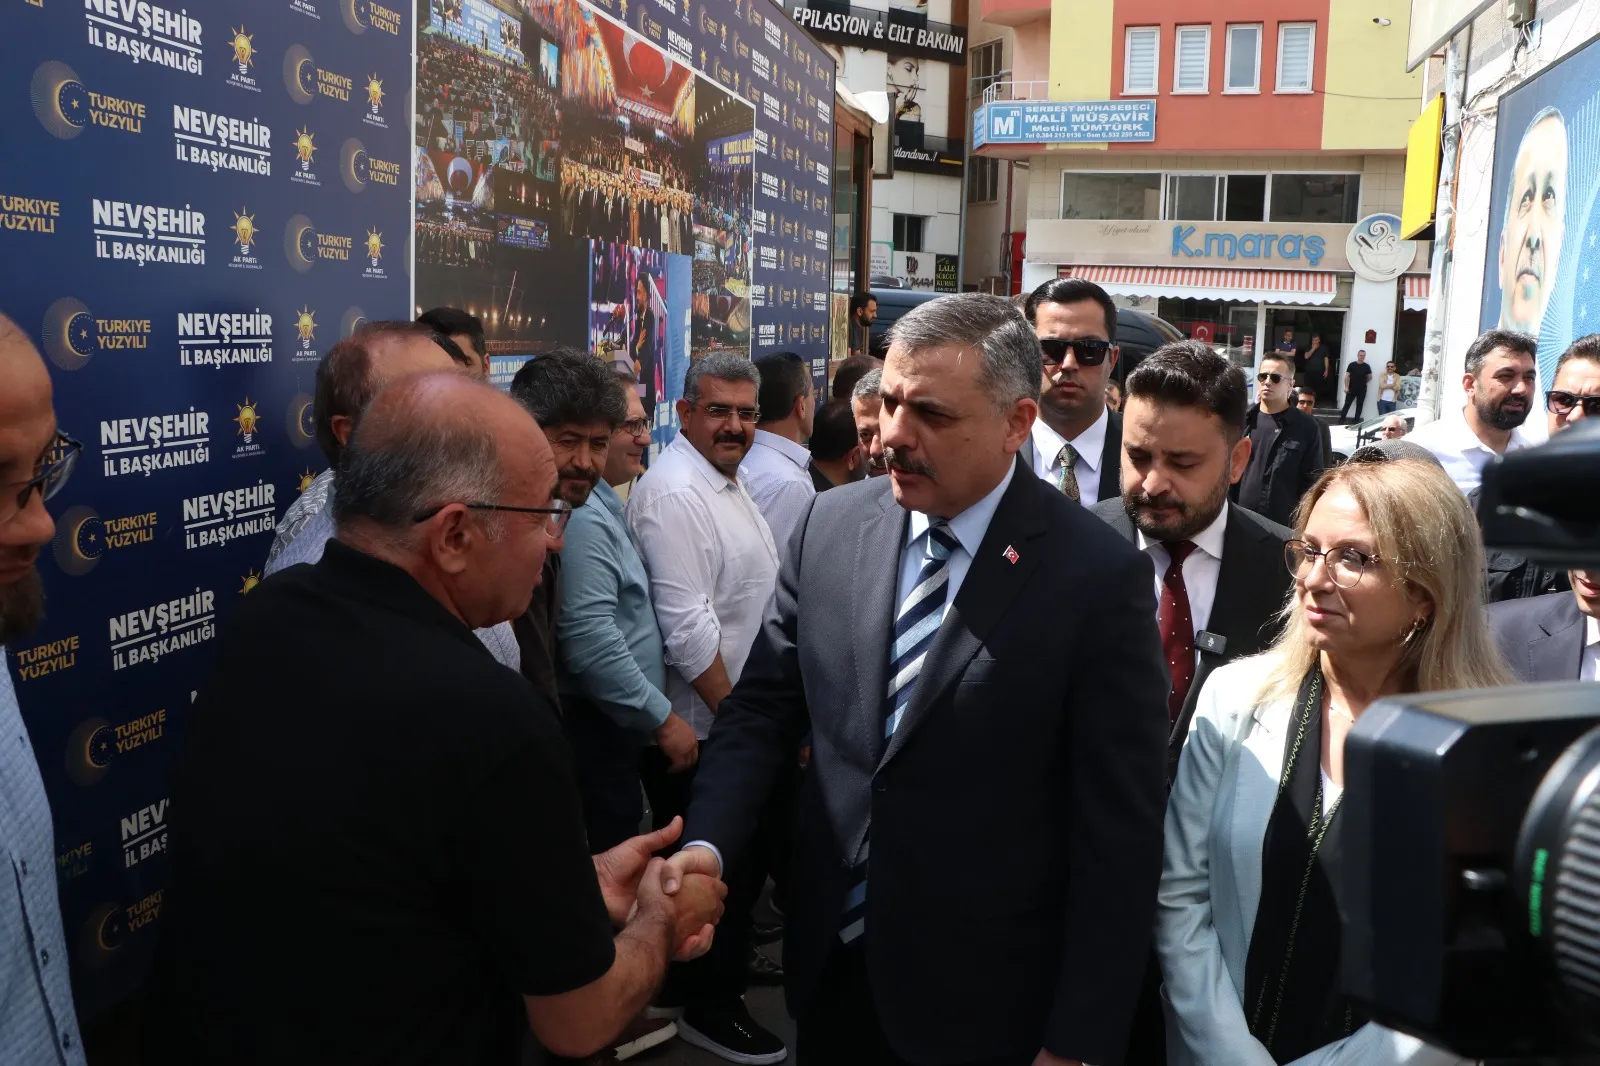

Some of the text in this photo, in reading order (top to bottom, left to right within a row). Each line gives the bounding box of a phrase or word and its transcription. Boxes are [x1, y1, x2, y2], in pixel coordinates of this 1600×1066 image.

[85, 0, 203, 46] NEVŞEHİR
[873, 20, 884, 40] &
[916, 30, 964, 54] BAKIMI
[88, 21, 203, 76] İL BAŞKANLIĞI
[316, 68, 353, 91] TÜRKİYE
[317, 82, 349, 102] YÜZYILI
[88, 91, 146, 119] TÜRKİYE
[89, 108, 142, 134] YÜZYILI
[1025, 112, 1150, 124] MALİ MÜŞAVİR
[173, 104, 272, 149] NEVŞEHİR
[1031, 122, 1143, 133] Metin TÜMTÜRK
[175, 139, 272, 177] İL BAŞKANLIĞI
[92, 198, 206, 240] NEVŞEHİR
[96, 235, 206, 267] İL BAŞKANLIĞI
[316, 233, 352, 249] TÜRKİYE
[317, 247, 349, 261] YÜZYILI
[1171, 224, 1326, 266] K.maraş
[96, 319, 151, 334] TÜRKİYE
[178, 307, 273, 343] NEVŞEHİR
[98, 334, 147, 350] YÜZYILI
[180, 344, 273, 370] İL BAŞKANLIĞI
[100, 405, 210, 450] NEVŞEHİR
[104, 443, 210, 477] İL BAŞKANLIĞI
[183, 478, 275, 522] NEVŞEHİR
[104, 512, 158, 534] TÜRKİYE
[105, 528, 154, 550] YÜZYILI
[186, 514, 276, 550] İL BAŞKANLIĞI
[109, 586, 215, 641] NEVŞEHİR
[17, 634, 80, 666] TÜRKİYE
[113, 622, 216, 670] İL BAŞKANLIĞI
[19, 651, 76, 681] YÜZYILI
[115, 708, 167, 740] TÜRKİYE
[116, 724, 163, 755] YÜZYILI
[121, 798, 170, 841] NEV
[125, 848, 138, 869] İL
